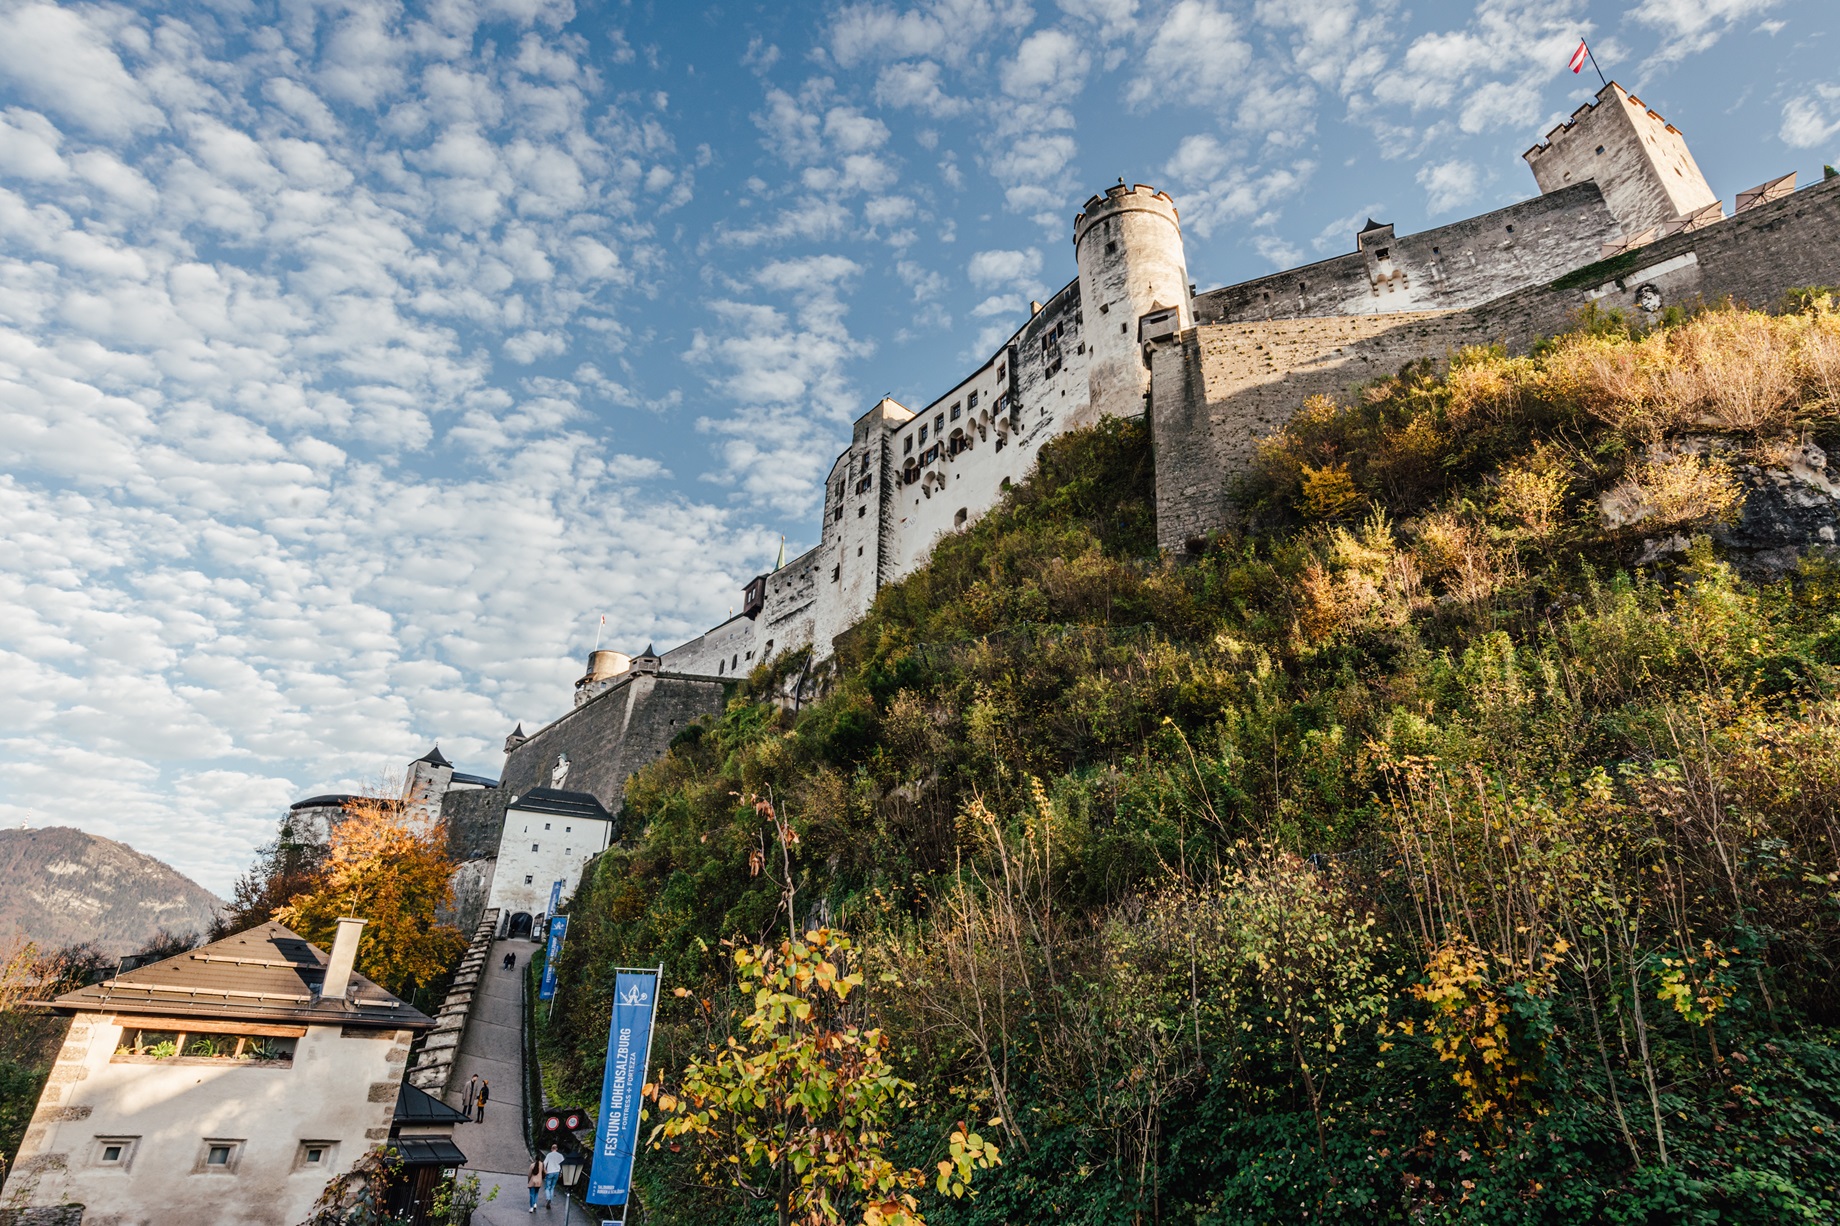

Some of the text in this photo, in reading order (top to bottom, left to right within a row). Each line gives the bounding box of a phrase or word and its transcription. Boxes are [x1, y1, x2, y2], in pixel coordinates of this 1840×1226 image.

[604, 1028, 631, 1156] FESTUNG HOHENSALZBURG
[622, 1095, 632, 1130] FORTRESS
[627, 1052, 636, 1086] FORTEZZA
